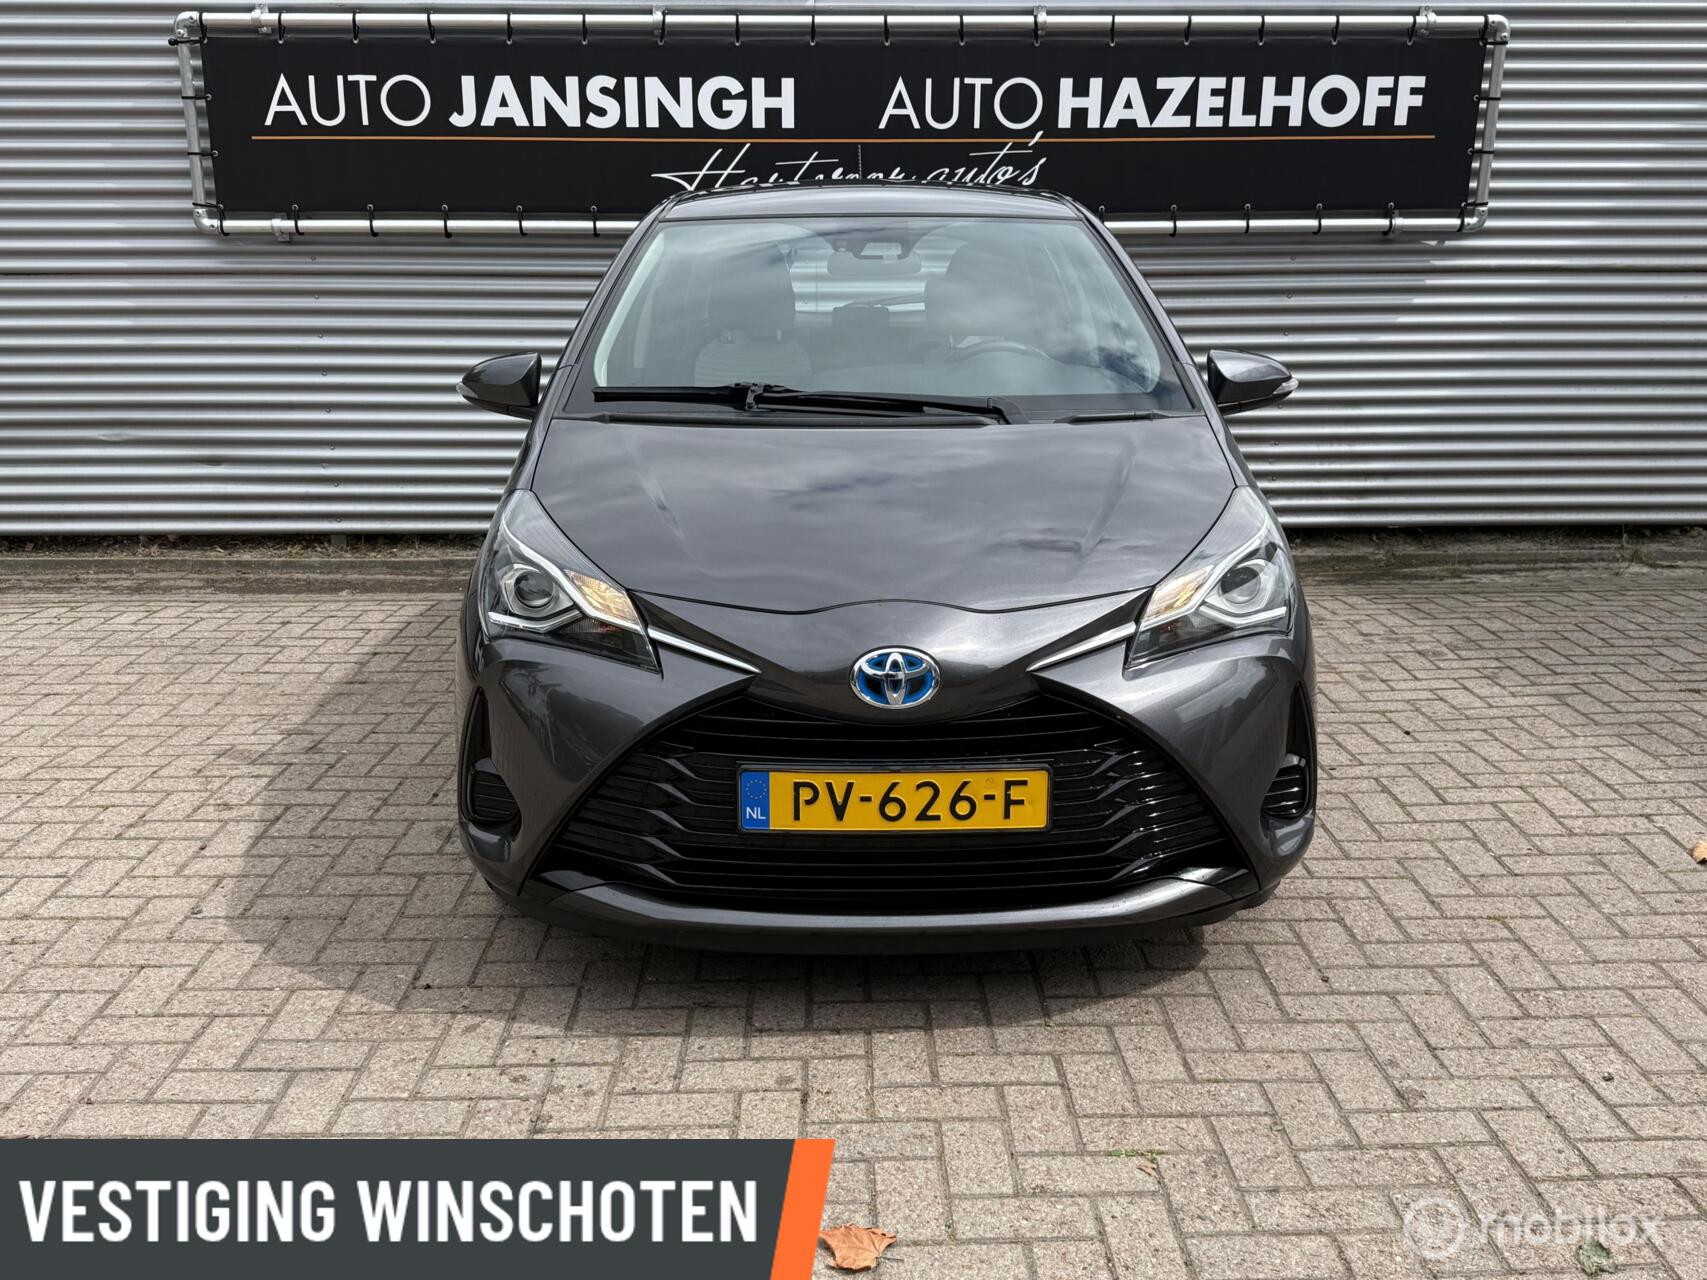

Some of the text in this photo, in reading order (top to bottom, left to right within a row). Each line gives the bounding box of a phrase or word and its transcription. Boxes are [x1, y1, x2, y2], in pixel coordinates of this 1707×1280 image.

[264, 73, 796, 130] AUTO JANSINGH
[878, 74, 1428, 129] AUTO HAZELHOFF
[745, 806, 766, 820] NL
[792, 779, 1029, 823] PV-626-F
